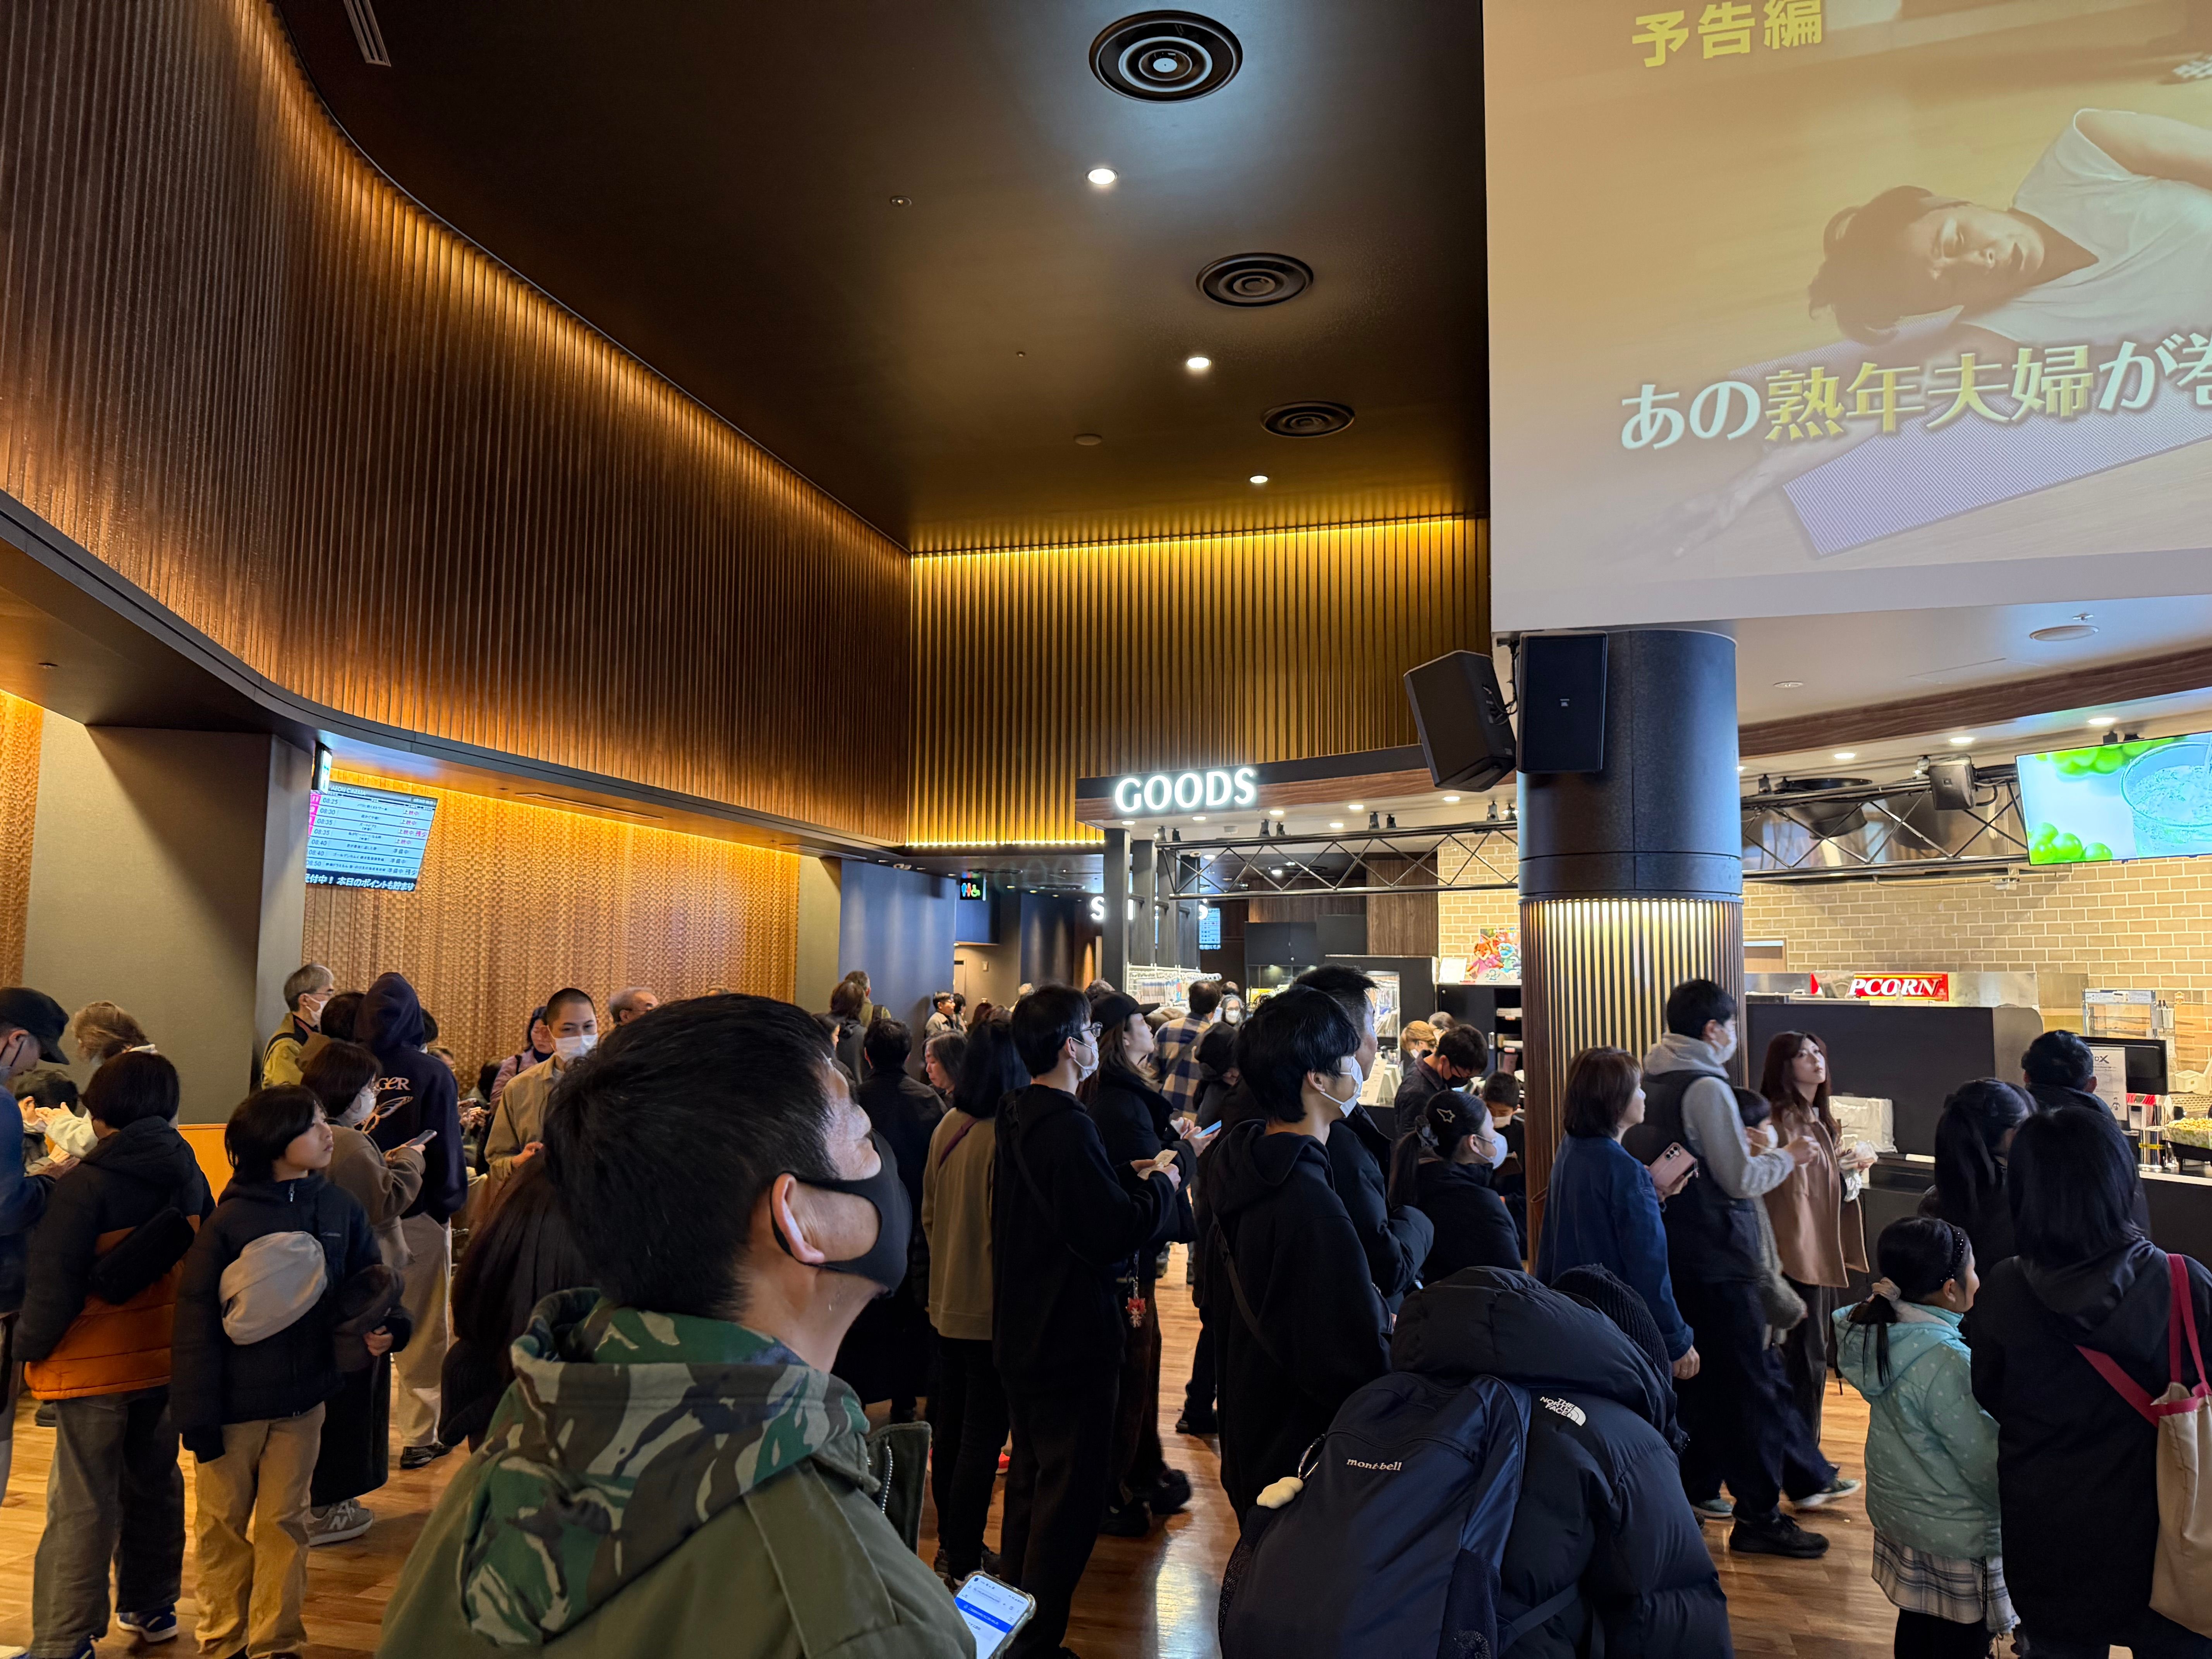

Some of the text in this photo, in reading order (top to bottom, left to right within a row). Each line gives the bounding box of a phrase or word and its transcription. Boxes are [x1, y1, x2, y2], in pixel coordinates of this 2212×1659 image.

[1632, 0, 1822, 67] 予告編
[1115, 767, 1256, 812] GOODS
[1848, 978, 1940, 996] PCORN
[1540, 1396, 1573, 1413] NORTH
[1545, 1403, 1568, 1417] FACE
[1558, 1398, 1575, 1408] THE
